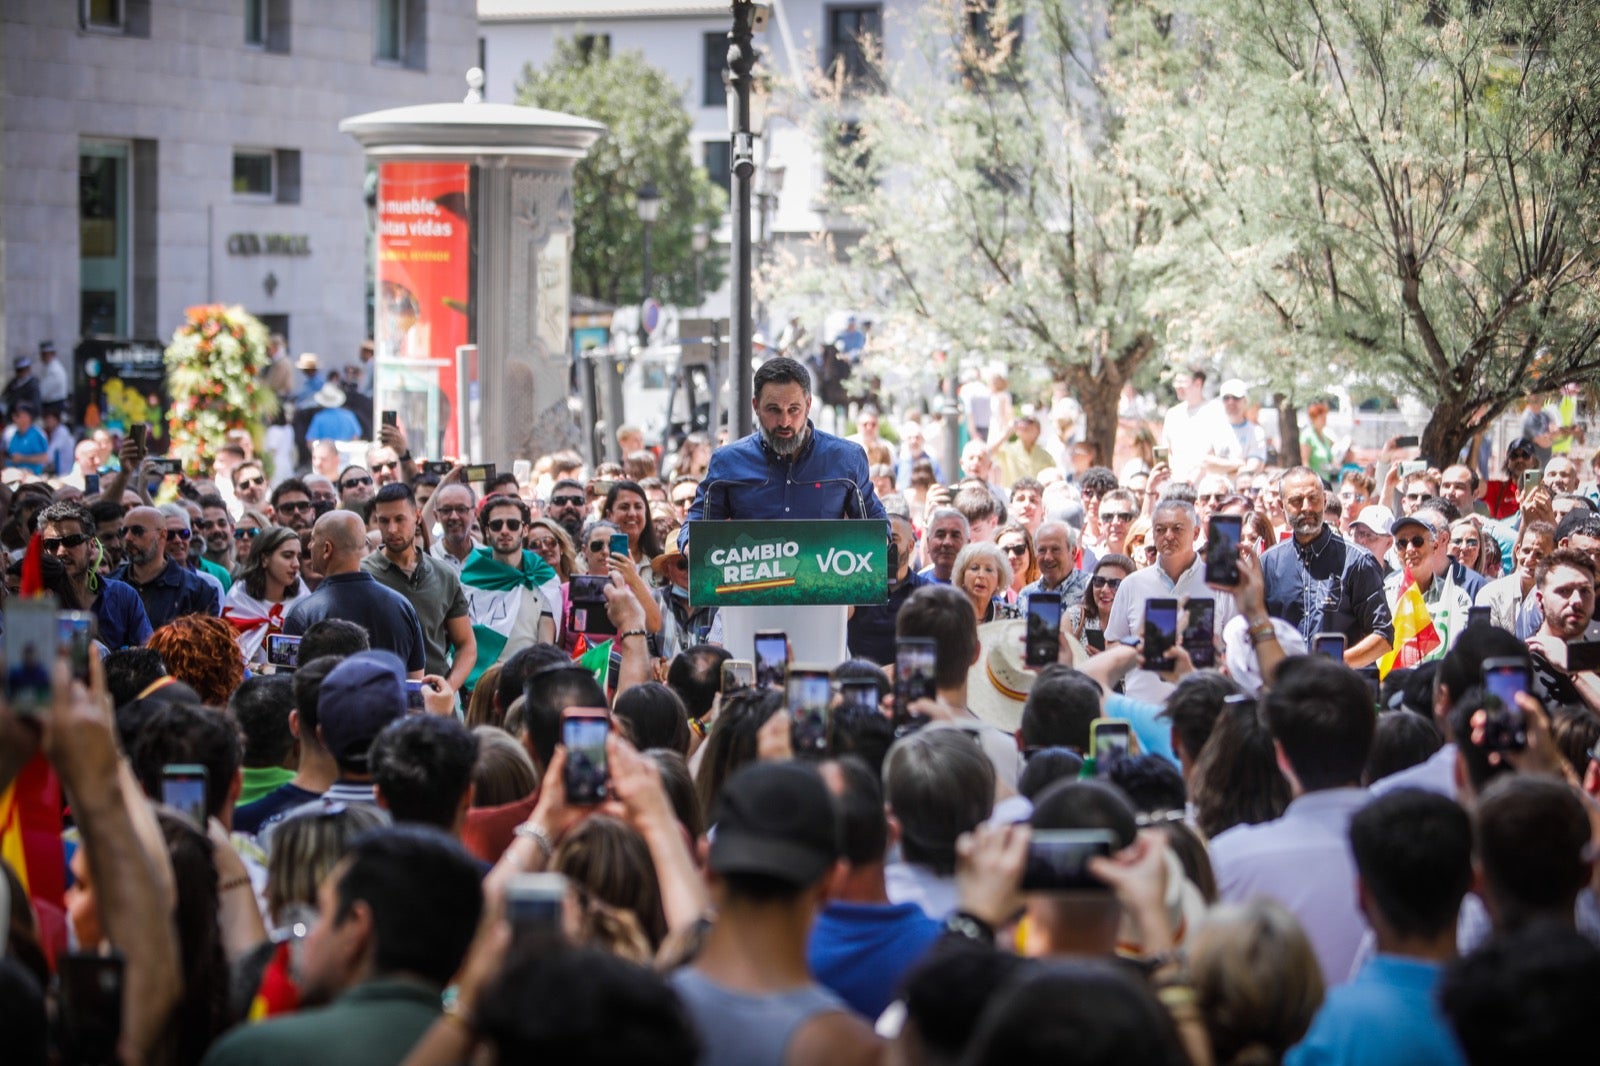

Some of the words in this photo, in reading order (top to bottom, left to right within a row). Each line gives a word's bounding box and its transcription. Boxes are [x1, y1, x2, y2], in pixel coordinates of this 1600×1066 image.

[386, 197, 441, 217] mueble,
[409, 218, 452, 237] vidas
[711, 541, 799, 566] CAMBIO
[816, 547, 873, 576] VOX
[724, 560, 786, 583] REAL
